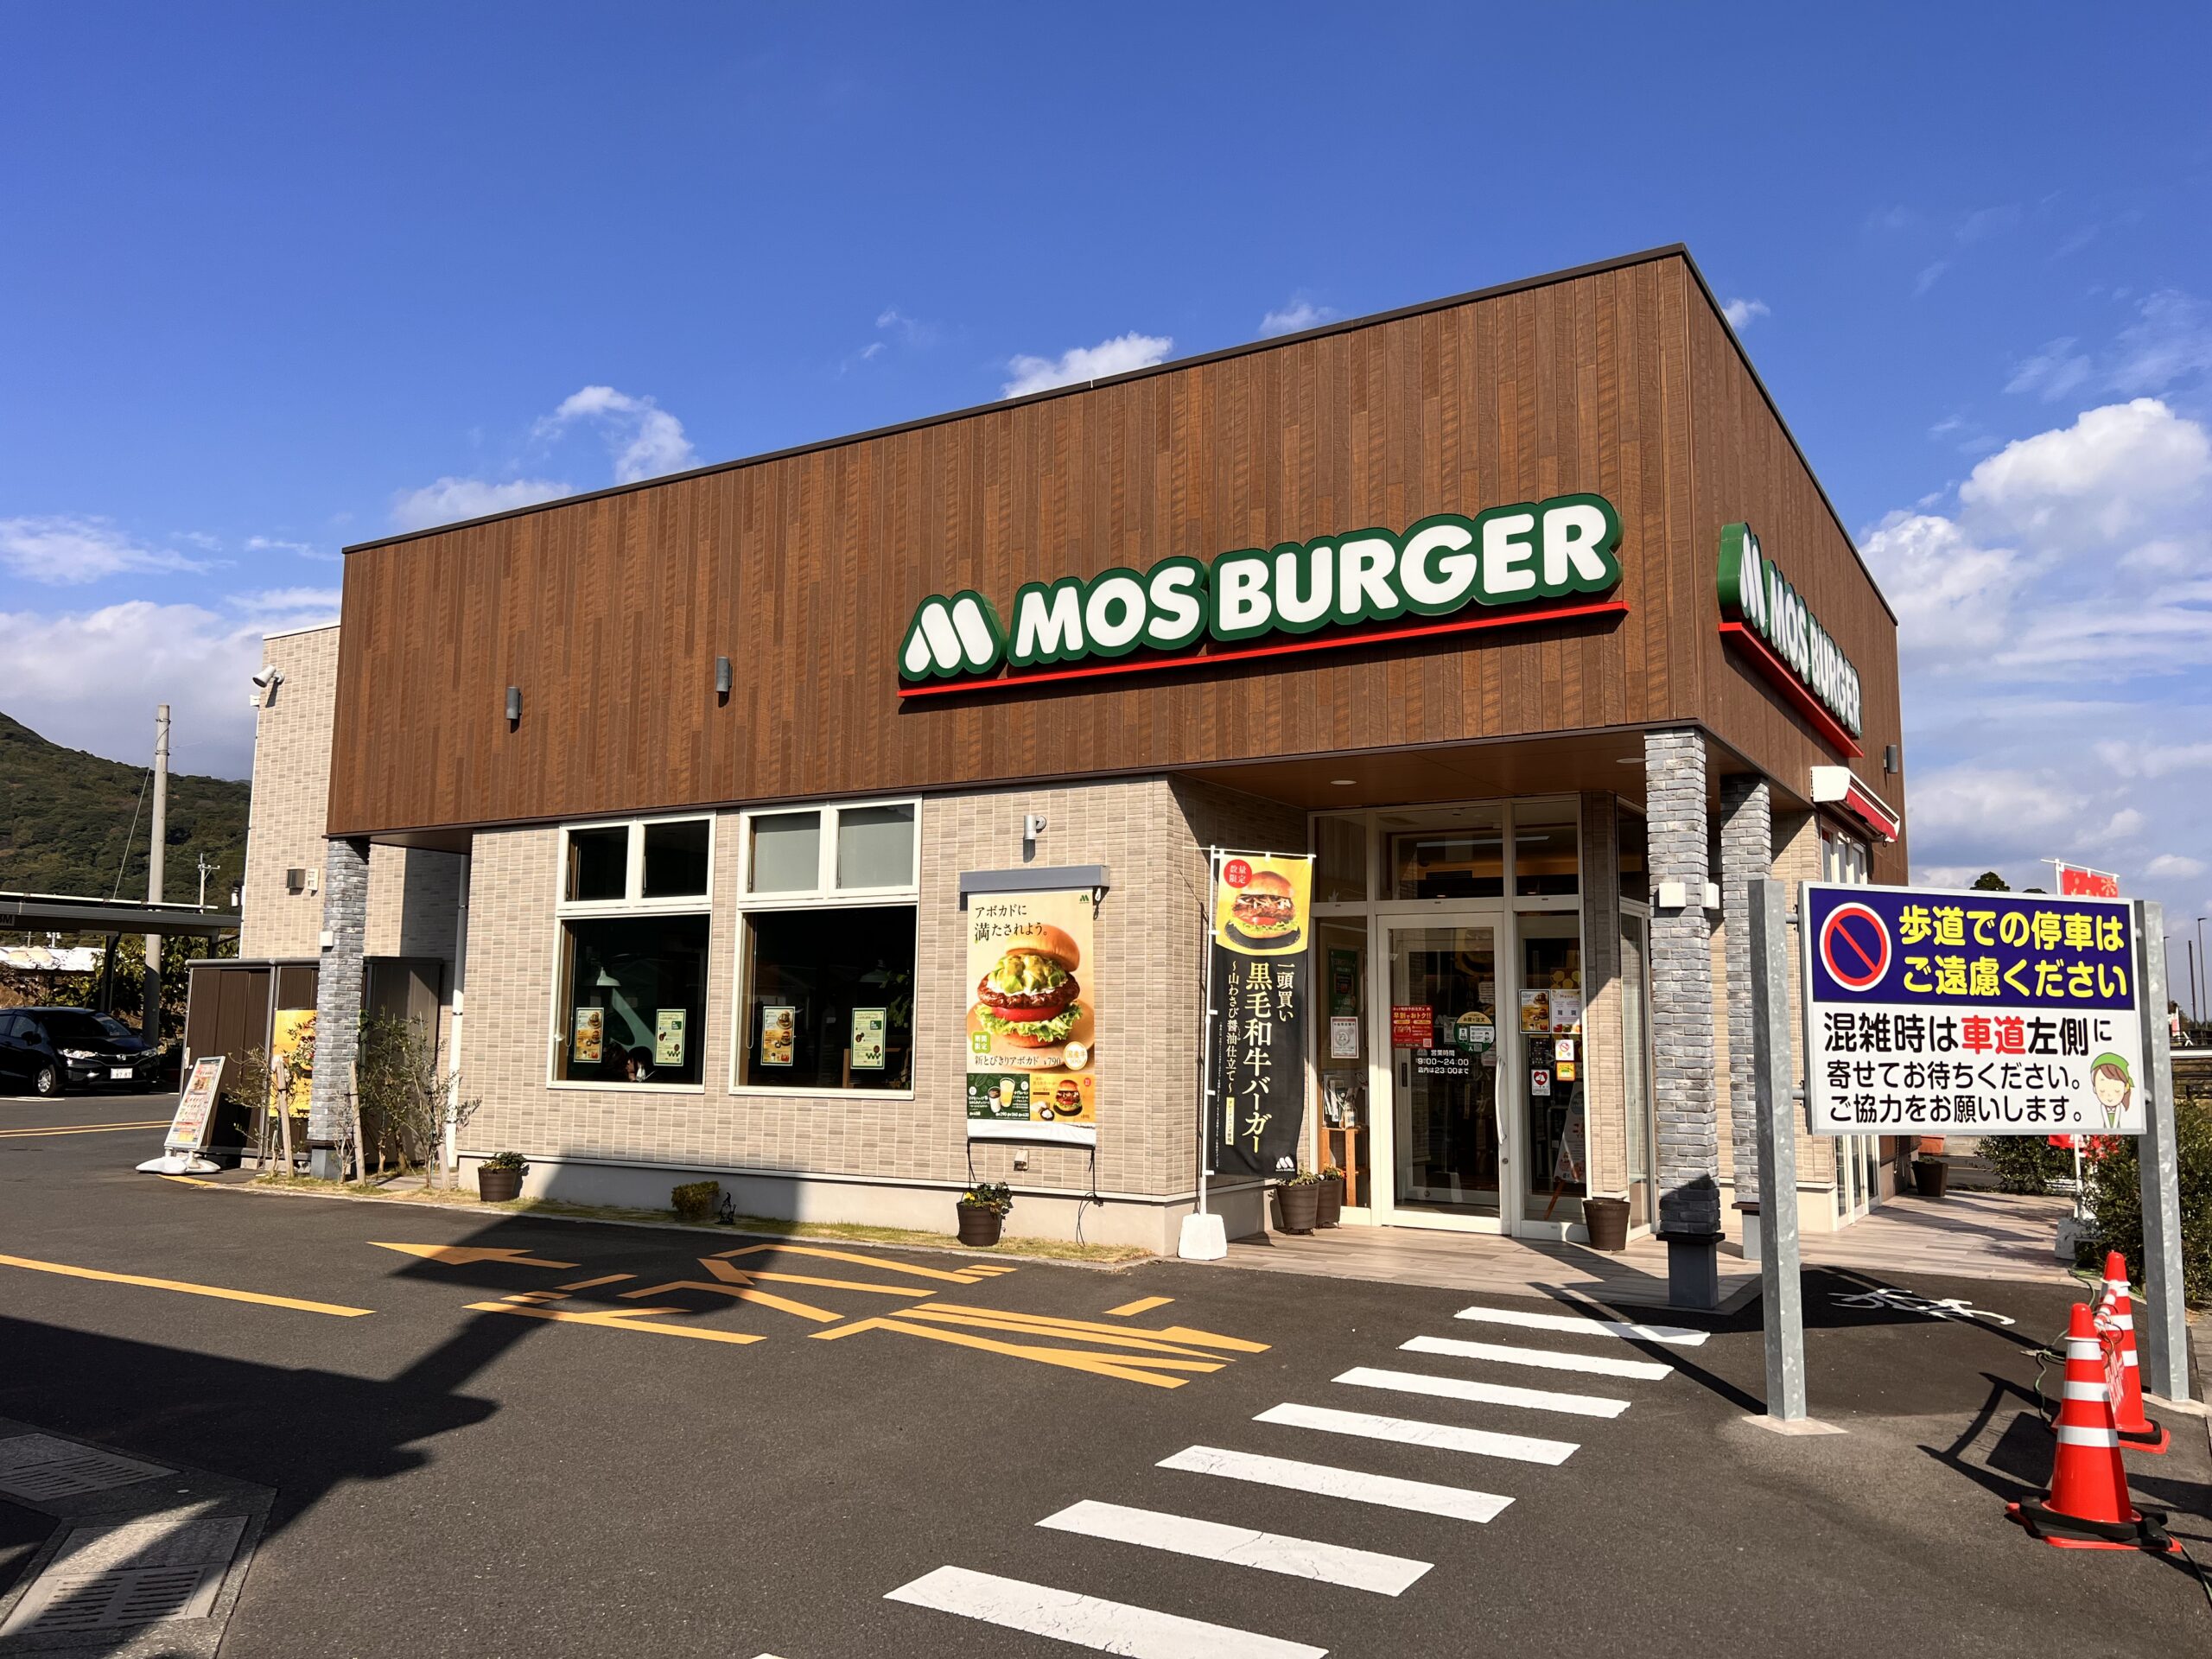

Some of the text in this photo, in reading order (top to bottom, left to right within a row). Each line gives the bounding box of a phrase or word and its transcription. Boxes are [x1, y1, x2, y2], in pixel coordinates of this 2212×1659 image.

[1014, 564, 1197, 658] MOS
[1218, 504, 1608, 632] BURGER
[1770, 569, 1808, 677] MOS
[1810, 622, 1861, 733] BURGER
[1229, 874, 1246, 883] 限定
[975, 904, 1027, 918] アボカドに
[1898, 905, 2125, 952] 歩道での停車は
[975, 922, 1047, 942] 満たされよう。
[1276, 963, 1295, 1022] 一頭買い
[1903, 956, 2127, 997] ご遠慮ください
[1823, 1012, 2113, 1056] 混雑時は車道左側に
[975, 1055, 1061, 1066] 新とびきりアボカド ¥790
[1242, 961, 1274, 1154] 黒毛和牛バーガー
[1418, 1066, 1469, 1075] 店内は23:00まで
[1827, 1060, 2081, 1090] 寄せてお待ちください。
[1829, 1094, 2082, 1123] ご協力をお願いします。
